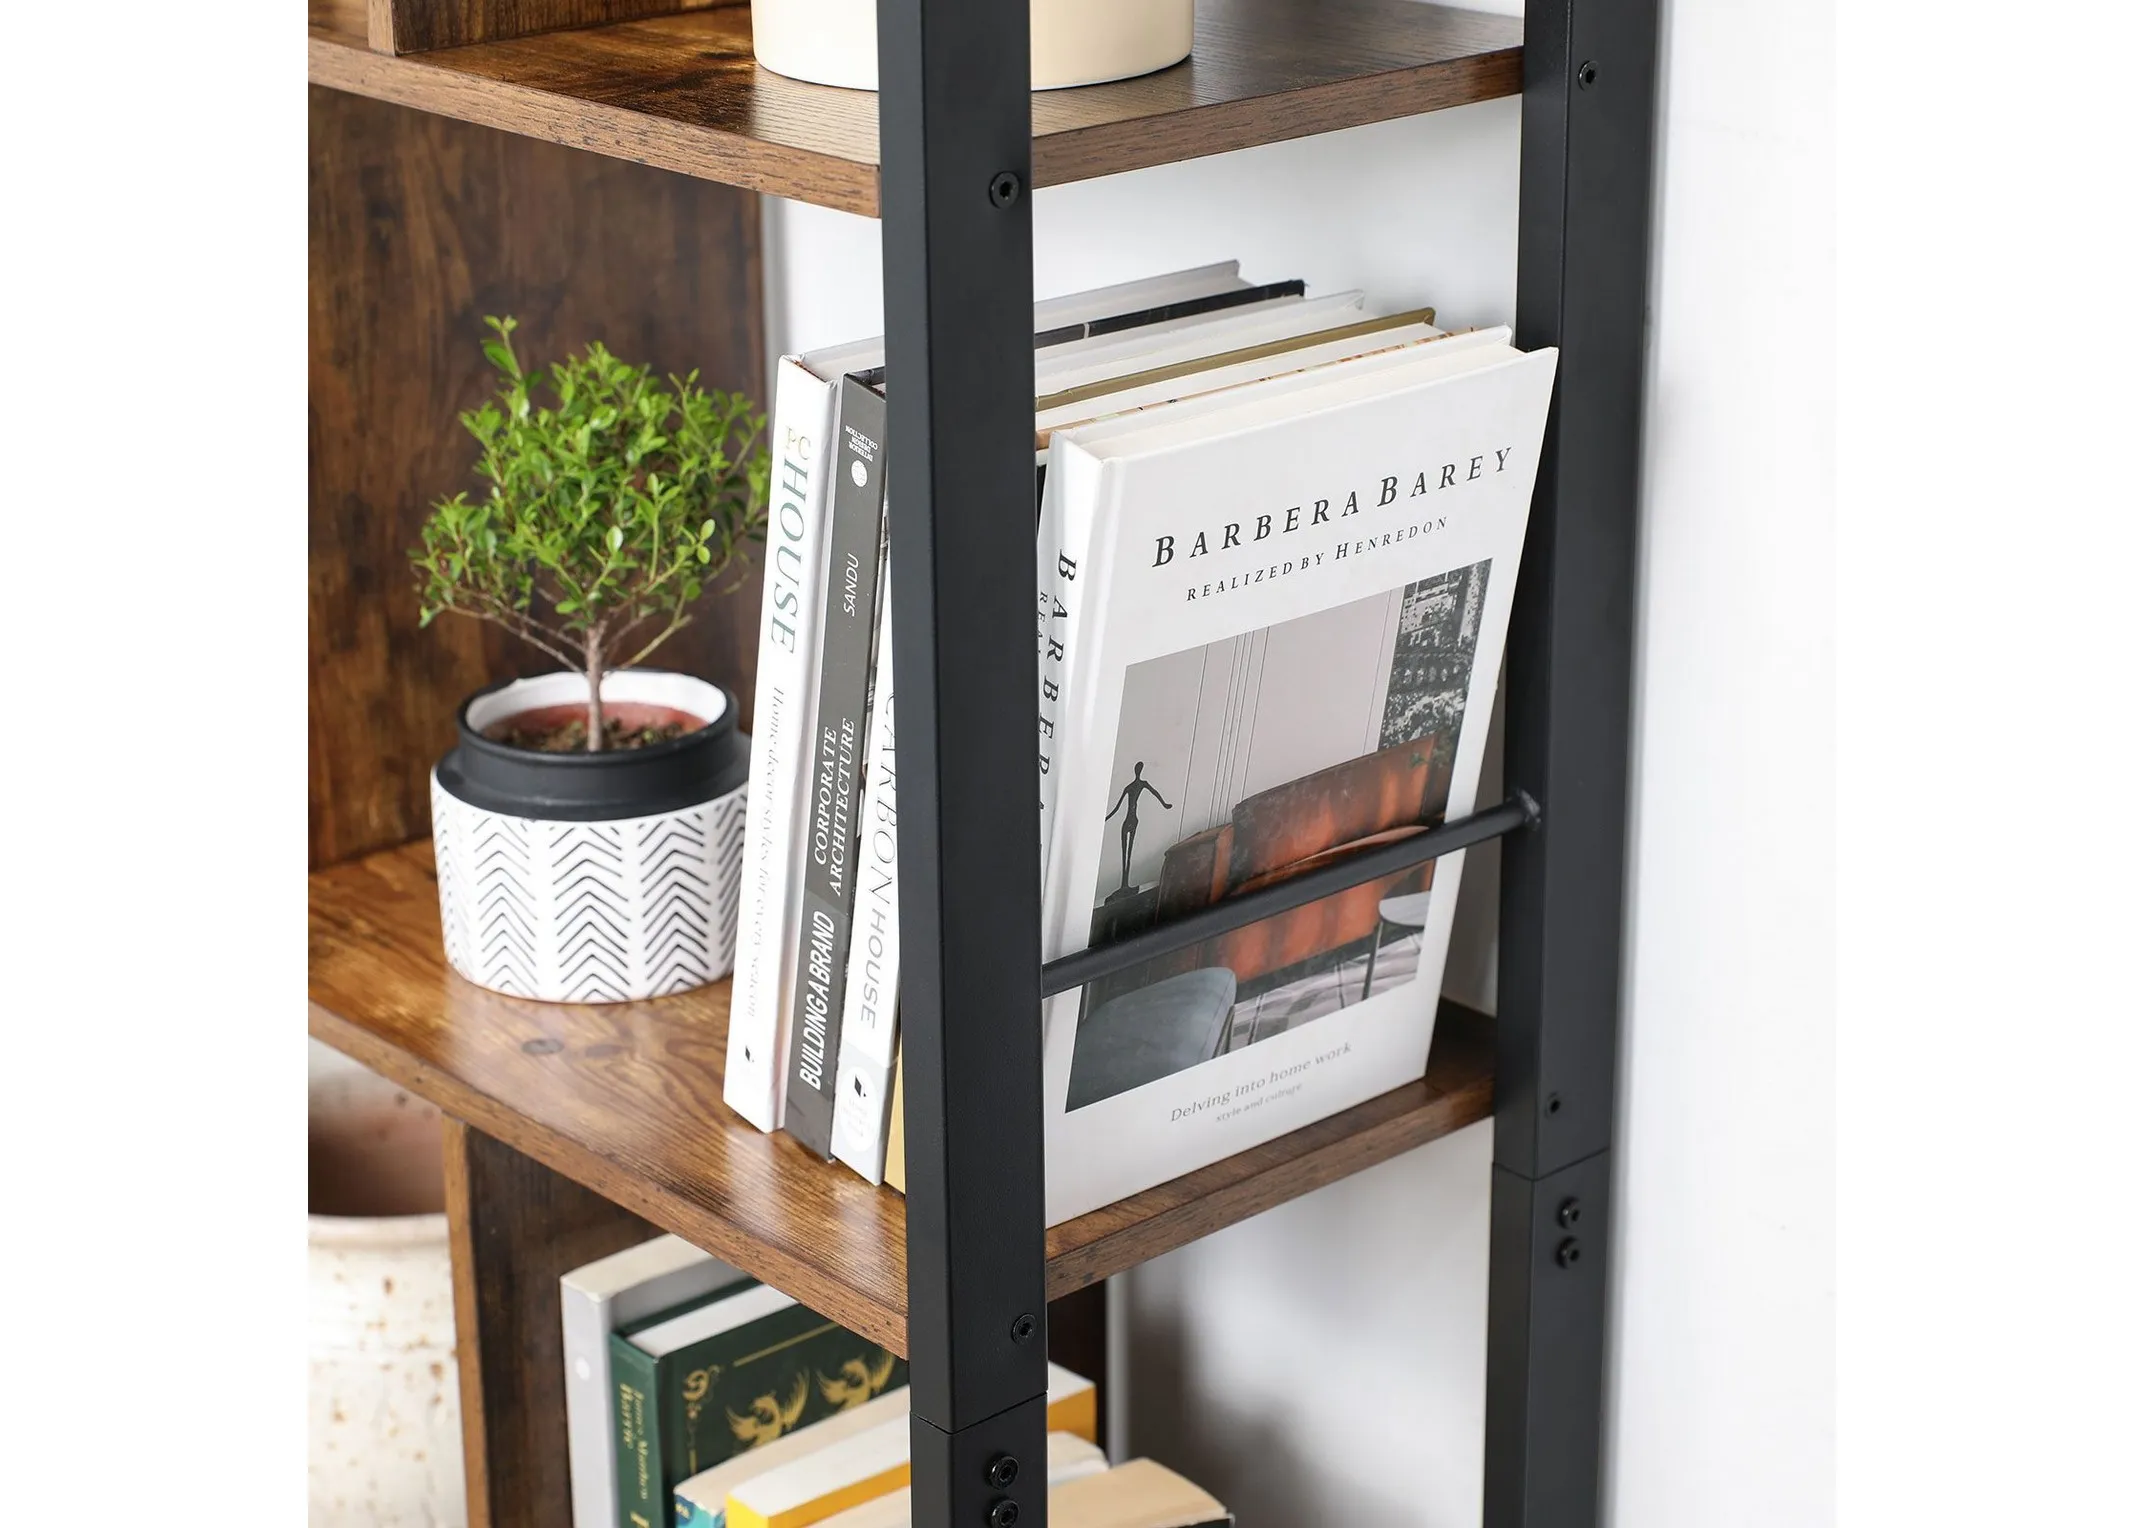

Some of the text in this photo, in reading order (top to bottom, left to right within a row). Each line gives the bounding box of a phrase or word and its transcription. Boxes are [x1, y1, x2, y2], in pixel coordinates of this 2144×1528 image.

[770, 454, 808, 655] HOUSE
[1151, 447, 1512, 568] BARBERA BAREY
[1186, 516, 1448, 602] REALIZED BY HENREDON
[843, 552, 860, 617] SANDU
[1039, 548, 1078, 811] BARBER
[813, 726, 837, 866] CORPORATE
[828, 717, 855, 898] ARCHITECTURE
[860, 907, 887, 1030] HOUSE
[1170, 1042, 1352, 1122] Delving into home work
[1244, 1096, 1264, 1112] and
